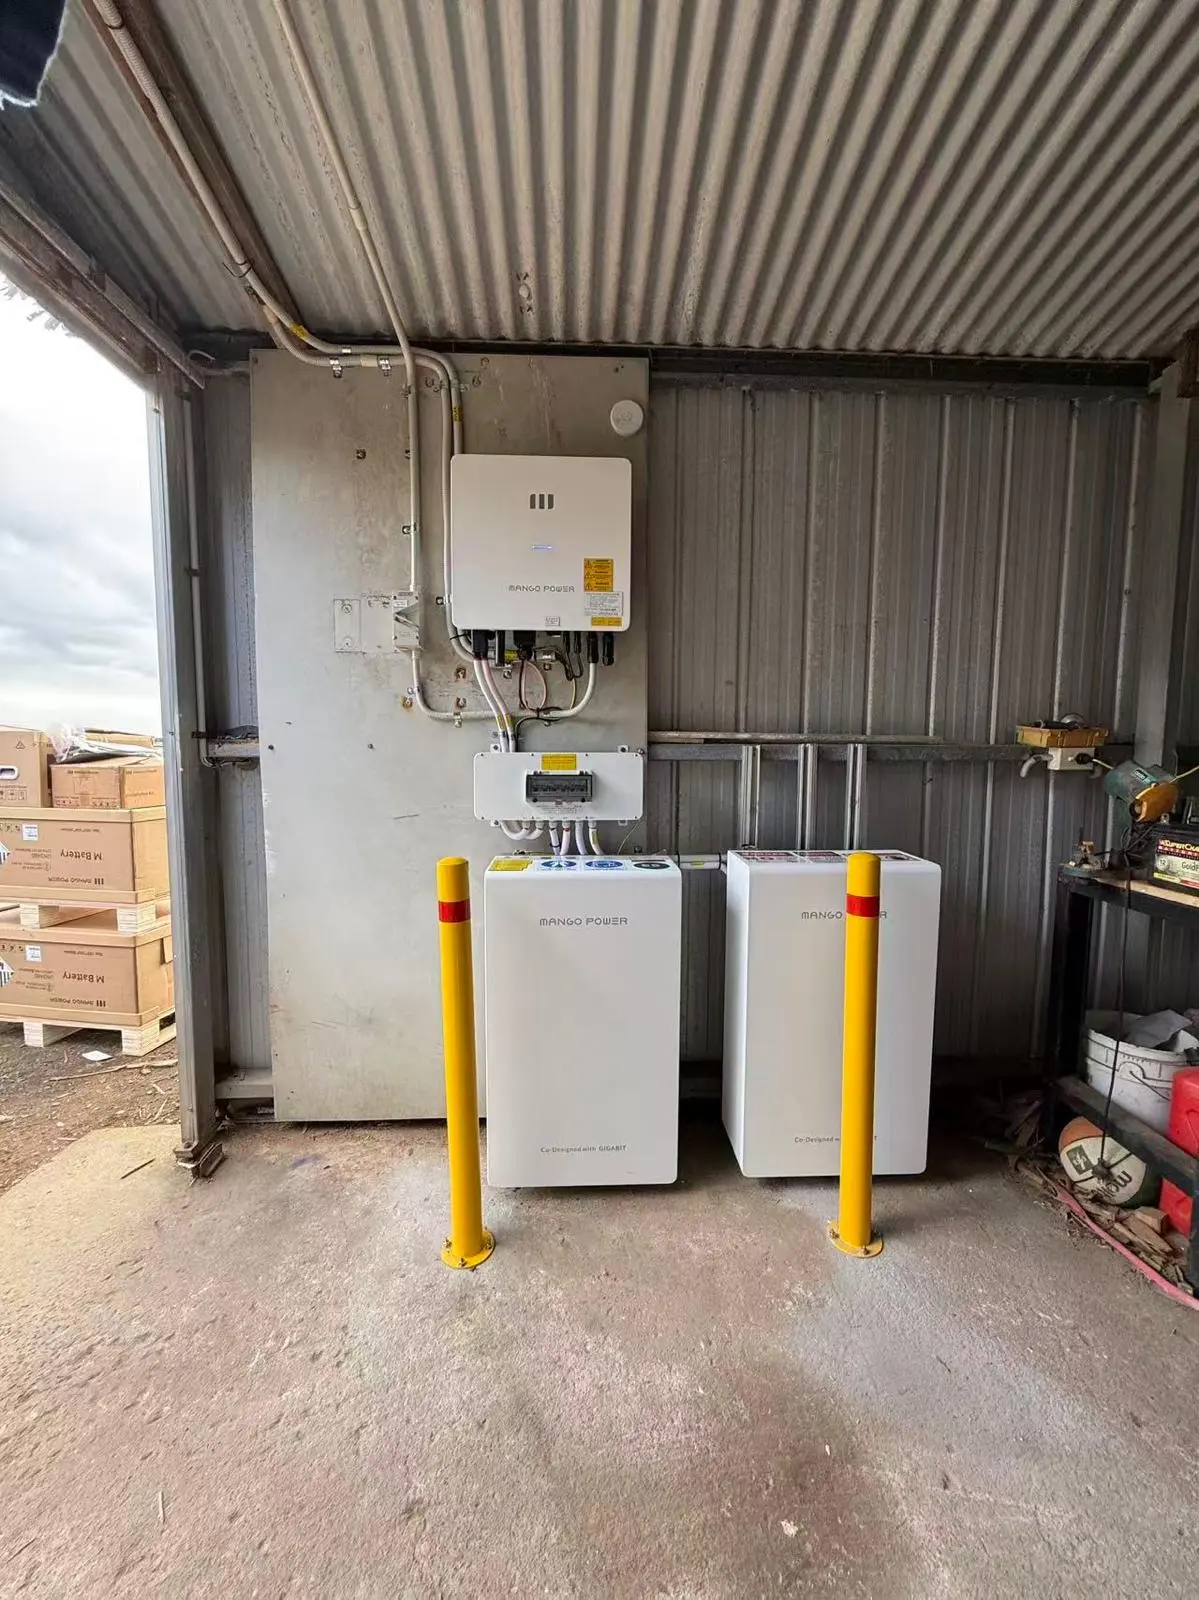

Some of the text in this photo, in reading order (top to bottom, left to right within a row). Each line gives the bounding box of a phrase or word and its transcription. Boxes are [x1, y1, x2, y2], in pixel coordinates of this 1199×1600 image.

[543, 585, 575, 593] POWER
[60, 849, 92, 860] Battery
[94, 853, 102, 861] M
[801, 911, 842, 920] MANGO
[539, 917, 628, 926] MANGO POWER
[62, 971, 94, 983] Battery
[96, 975, 105, 984] M
